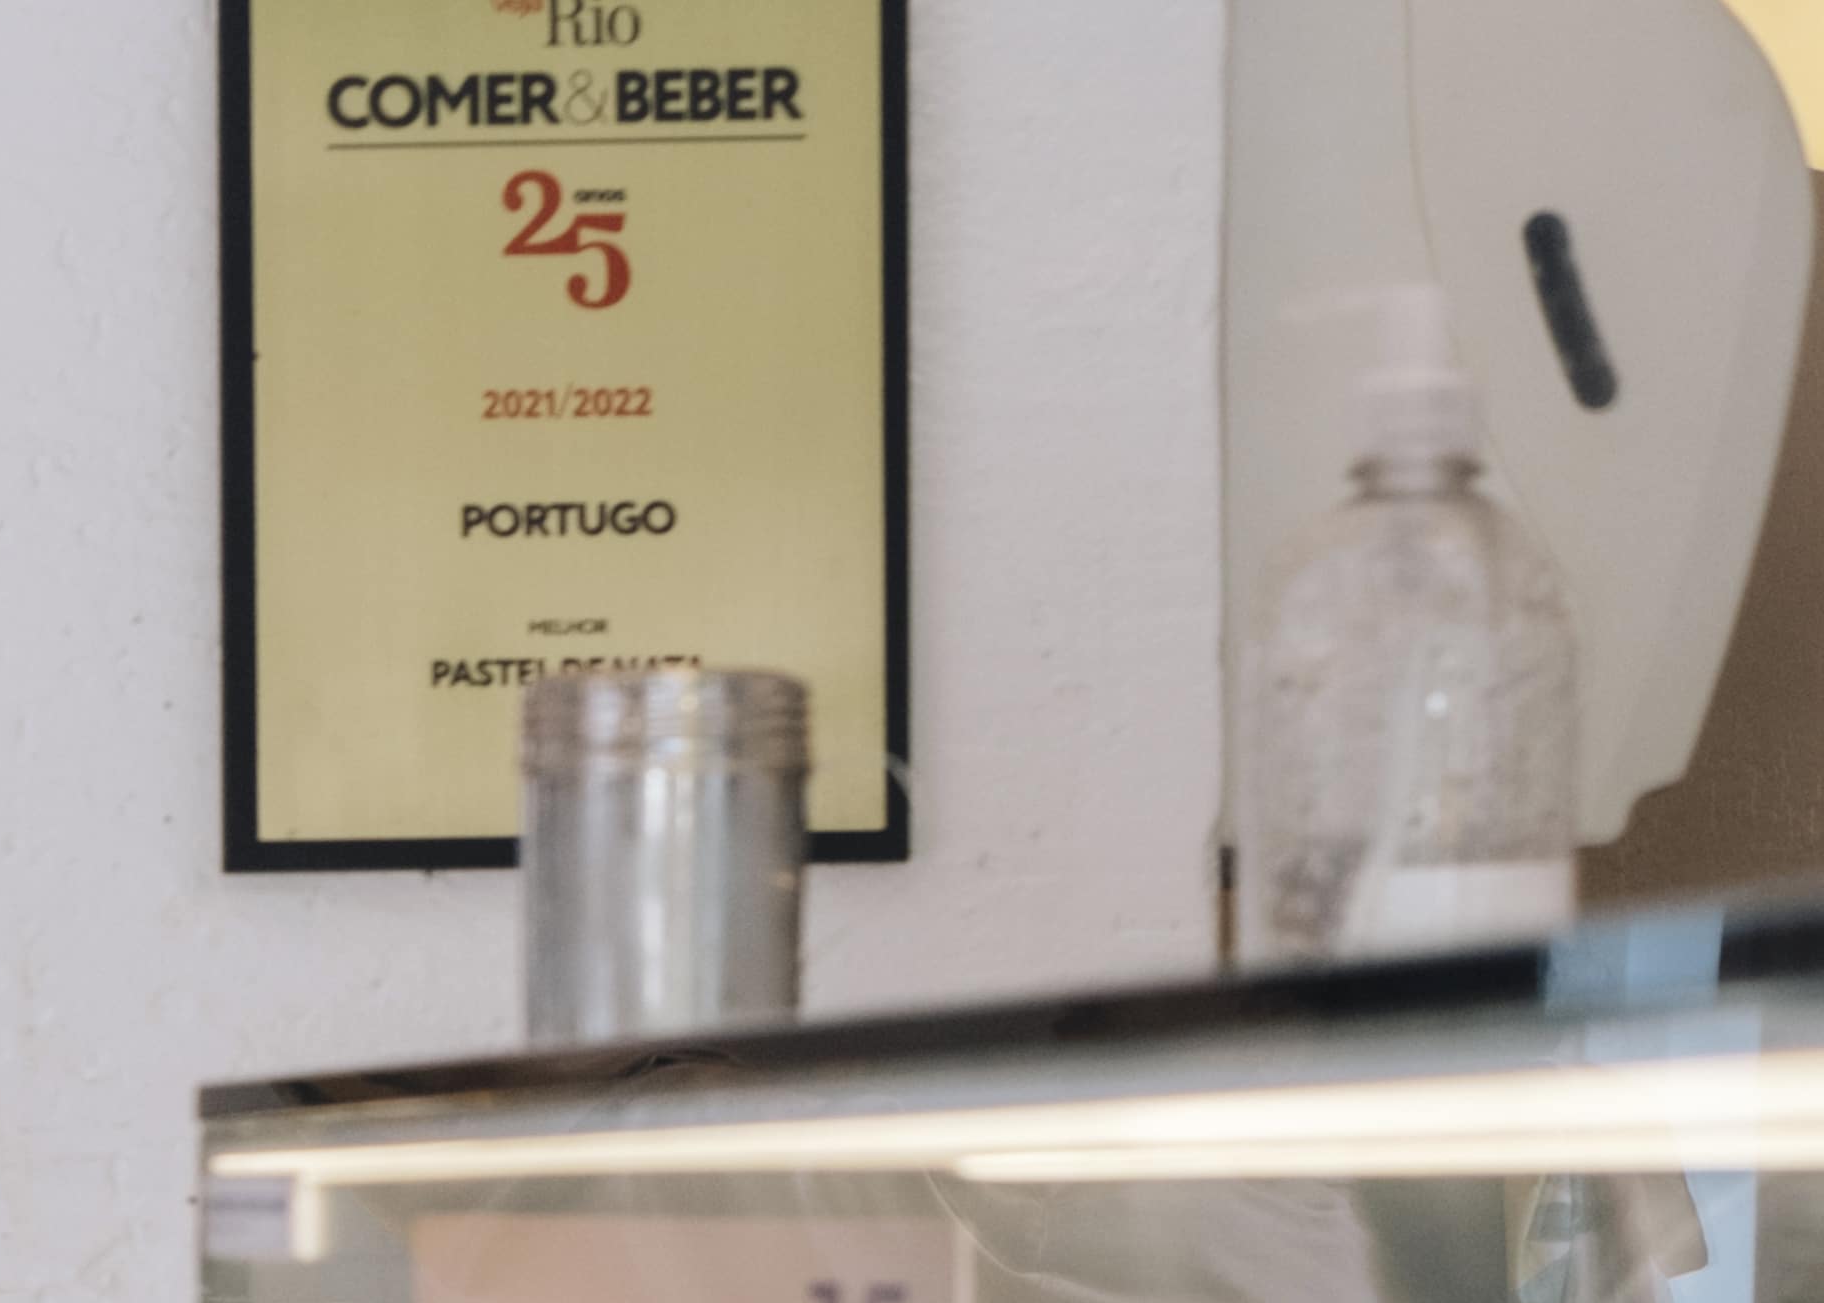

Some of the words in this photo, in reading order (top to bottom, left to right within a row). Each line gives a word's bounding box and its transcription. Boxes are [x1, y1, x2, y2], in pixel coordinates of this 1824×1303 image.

[544, 0, 642, 47] Rio
[501, 169, 631, 309] 25
[482, 383, 652, 420] 2021/2022
[461, 500, 676, 538] PORTUGO
